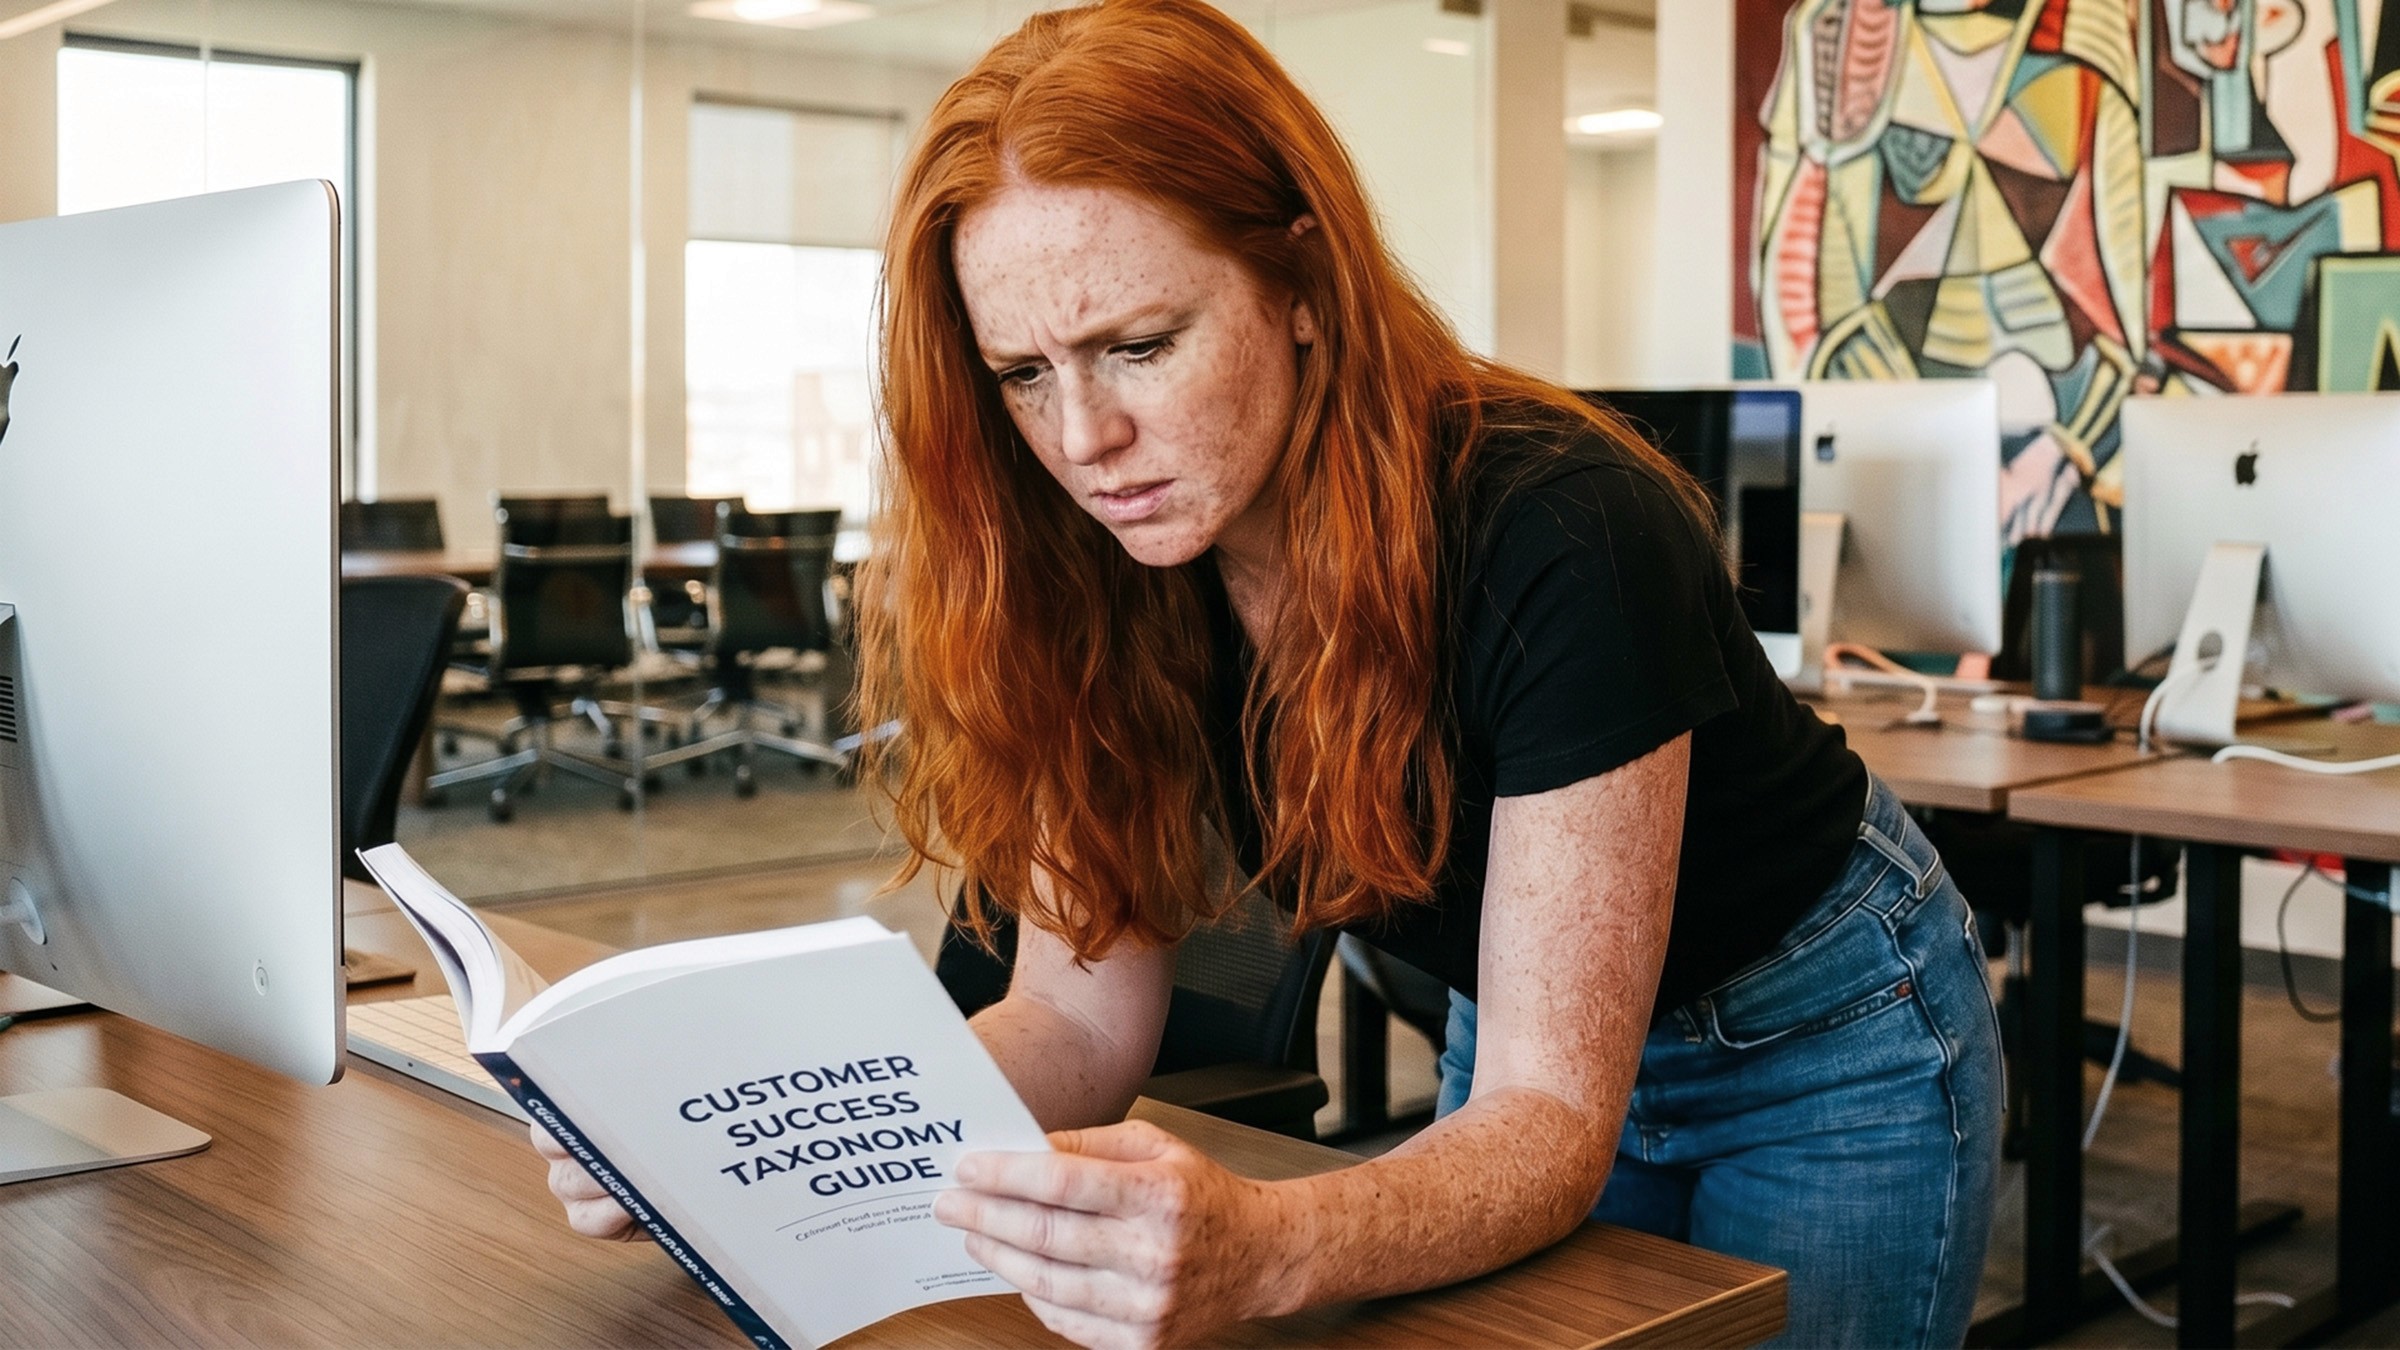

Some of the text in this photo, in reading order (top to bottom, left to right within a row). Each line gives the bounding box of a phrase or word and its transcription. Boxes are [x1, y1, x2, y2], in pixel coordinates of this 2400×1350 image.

[679, 1055, 919, 1123] CUSTOMER
[726, 1091, 921, 1148] SUCCESS
[720, 1119, 963, 1186] TAXONOMY
[809, 1156, 943, 1197] GUIDE
